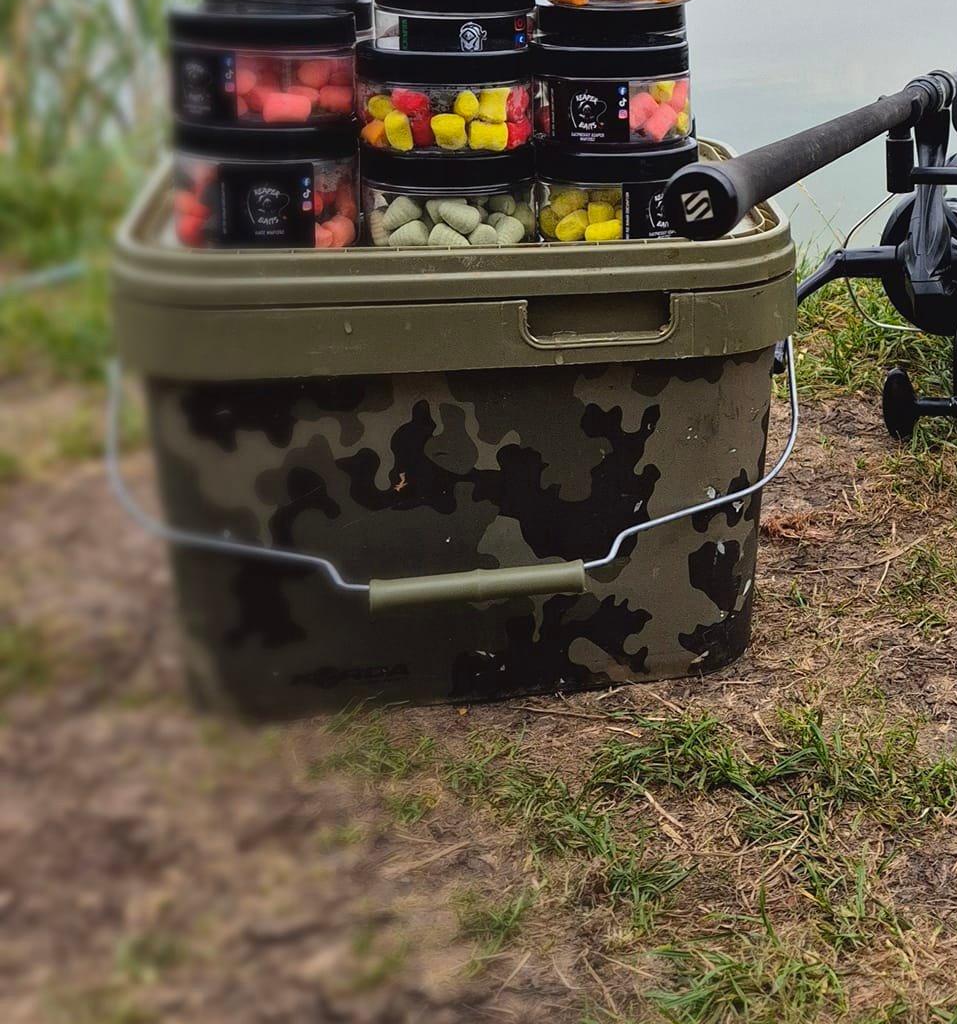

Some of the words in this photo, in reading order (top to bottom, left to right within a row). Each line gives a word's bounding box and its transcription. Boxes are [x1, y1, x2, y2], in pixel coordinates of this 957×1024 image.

[576, 94, 599, 106] REAPER
[578, 121, 598, 131] BAITS
[253, 187, 281, 199] REAPER
